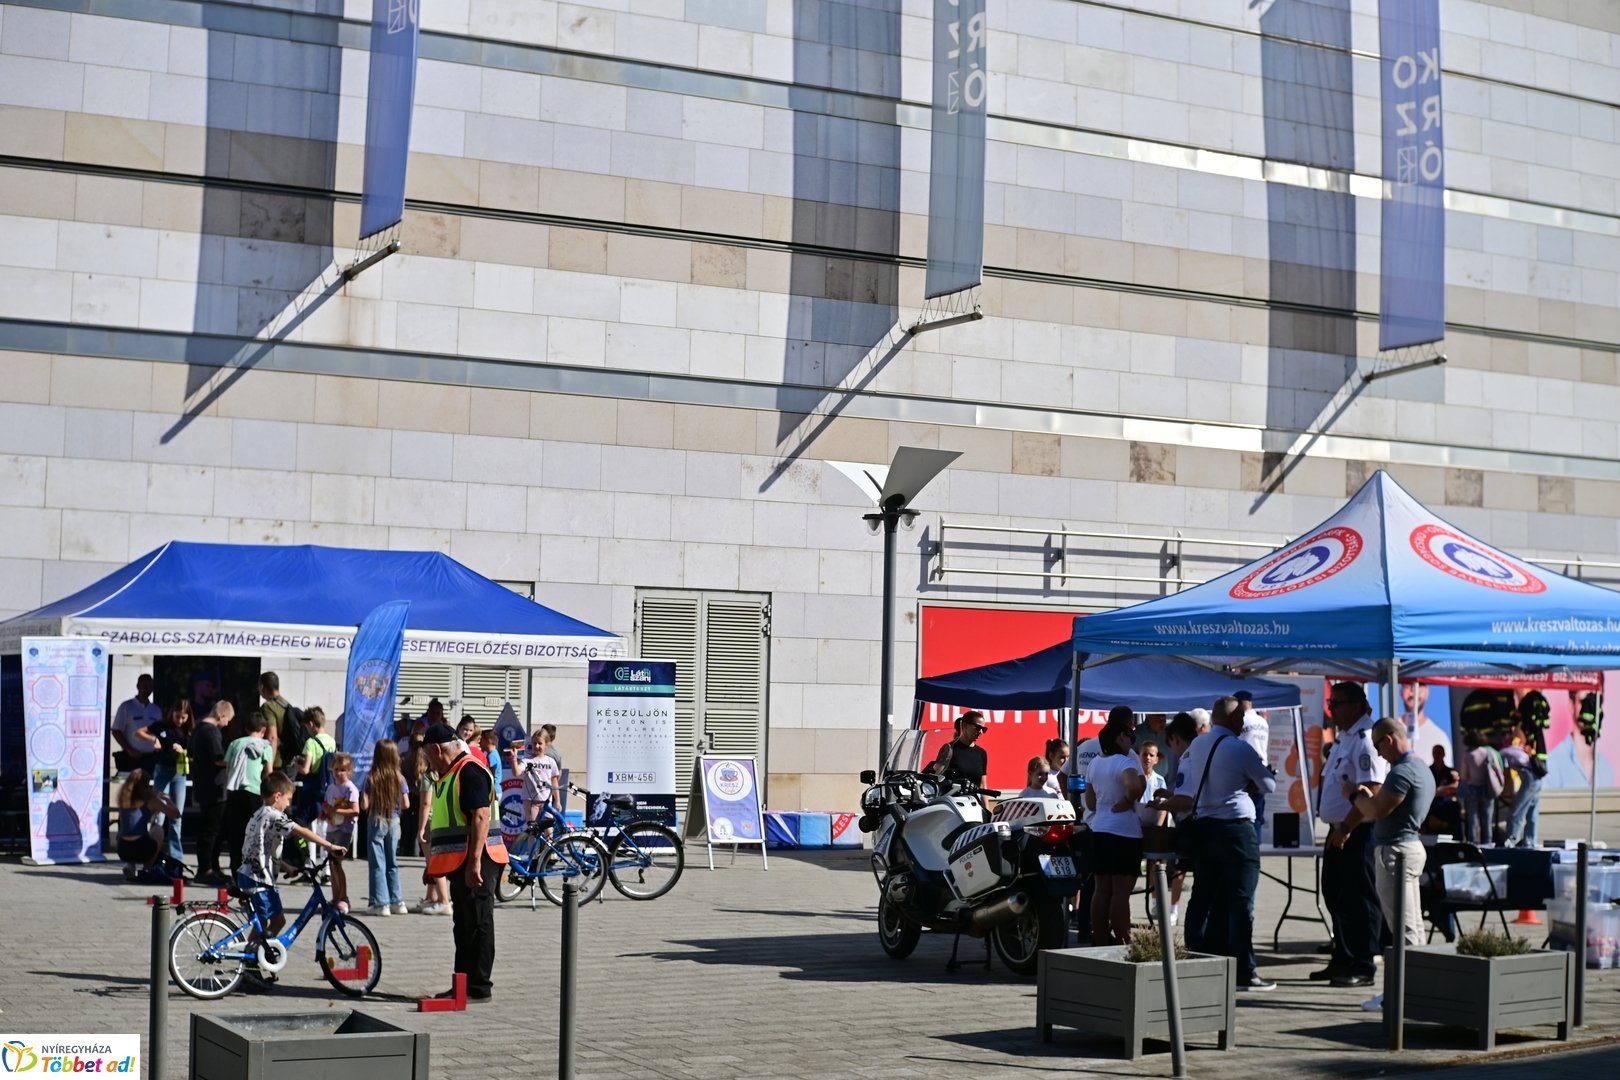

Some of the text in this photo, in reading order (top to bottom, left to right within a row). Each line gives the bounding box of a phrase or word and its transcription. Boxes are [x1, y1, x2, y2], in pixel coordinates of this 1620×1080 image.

[1154, 620, 1290, 635] www.kreszvaltozas.hu
[402, 640, 520, 655] ESETMEGELŐZÉSI
[525, 644, 598, 658] BIZOTTSÁG
[596, 708, 668, 717] KÉSZÜLJÖN
[615, 773, 653, 782] XBM-456
